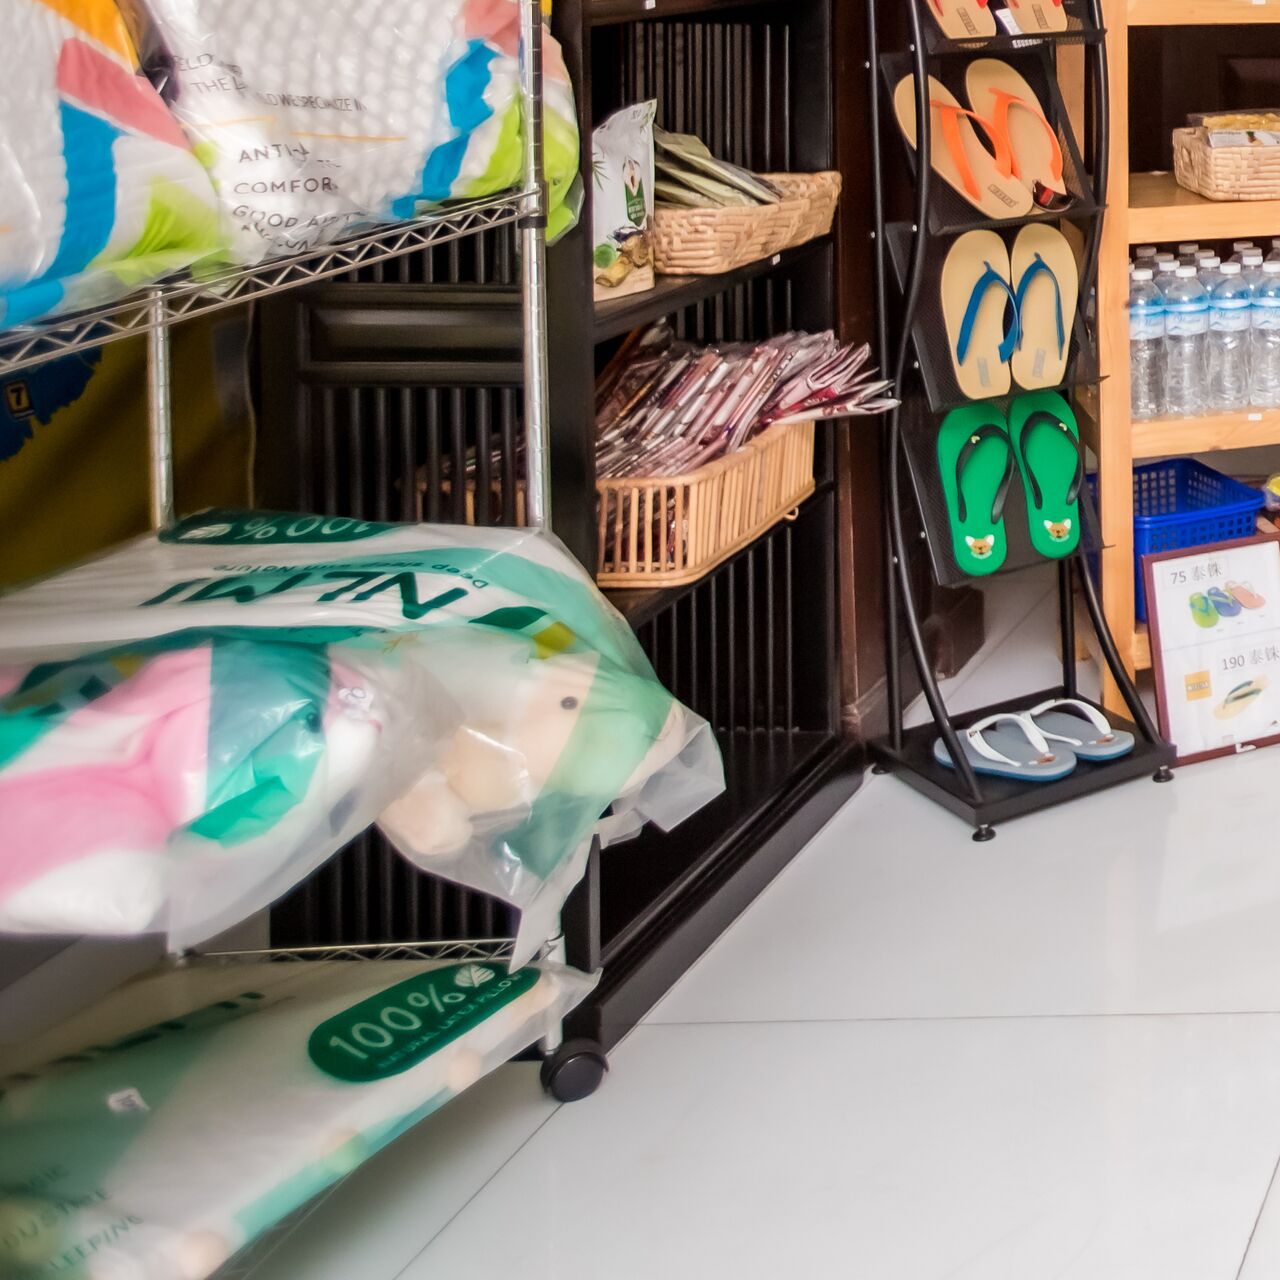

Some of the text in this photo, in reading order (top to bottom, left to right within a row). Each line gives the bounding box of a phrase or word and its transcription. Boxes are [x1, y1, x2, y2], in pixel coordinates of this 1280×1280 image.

[191, 77, 231, 94] THE
[232, 204, 299, 228] GOOD
[1170, 571, 1187, 585] 75
[1223, 654, 1246, 671] 190
[328, 983, 468, 1061] 100%
